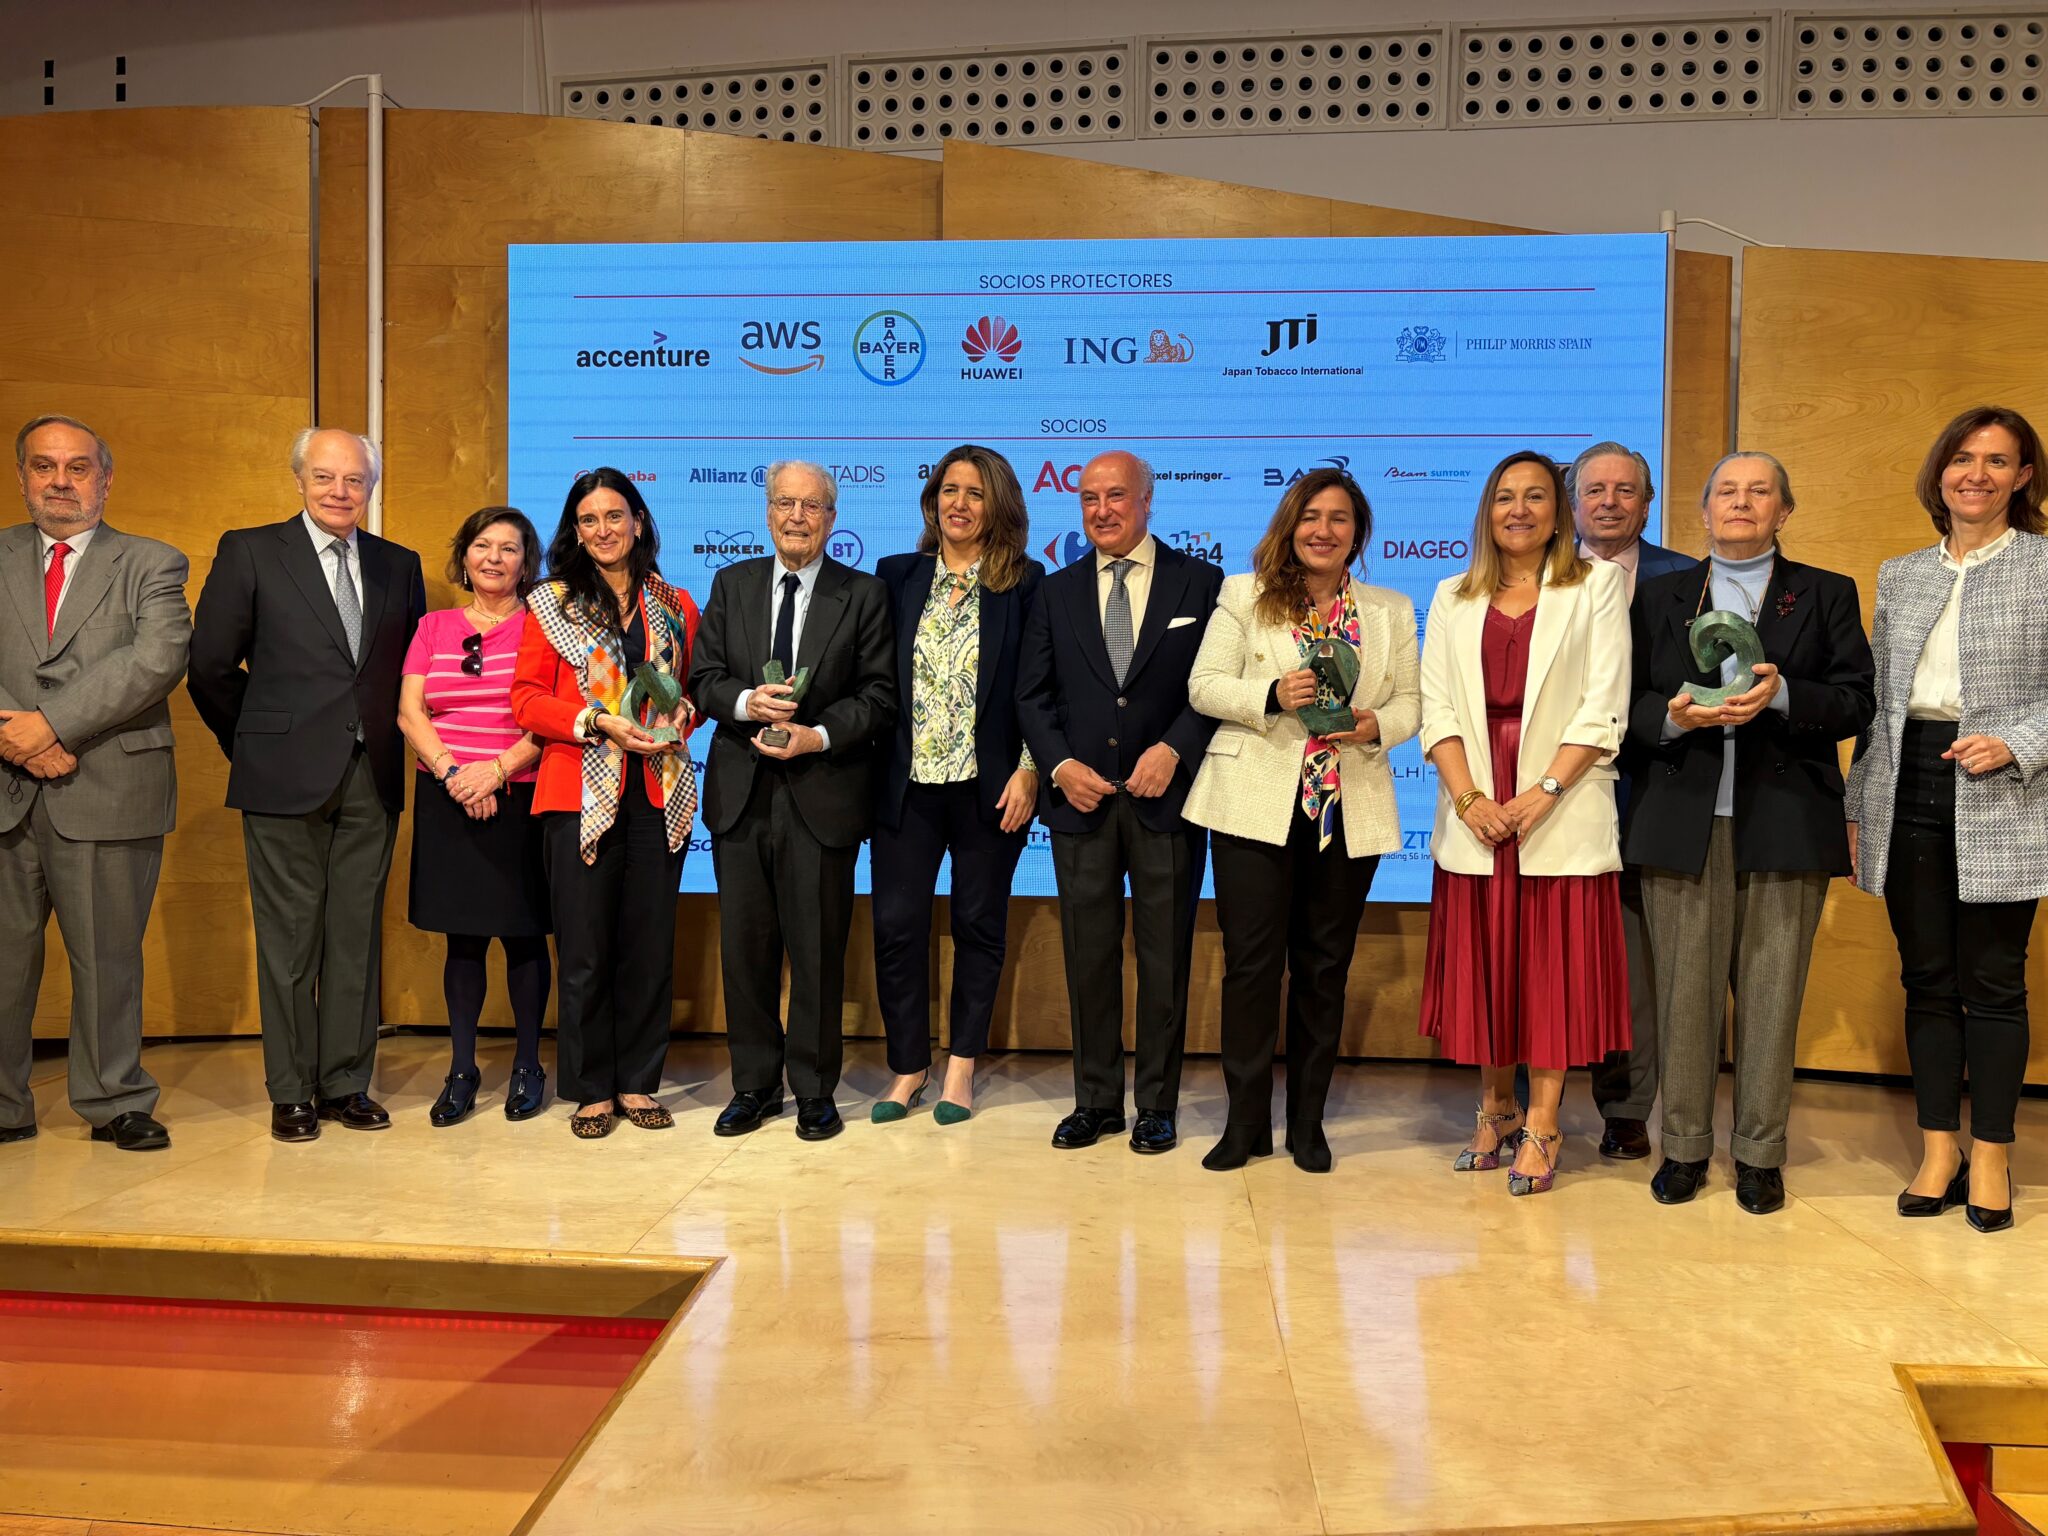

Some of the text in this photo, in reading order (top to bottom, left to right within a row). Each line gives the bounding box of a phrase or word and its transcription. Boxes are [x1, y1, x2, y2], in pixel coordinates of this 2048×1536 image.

[979, 273, 1173, 289] SOCIOS PROTECTORES
[741, 321, 822, 350] aws
[860, 342, 920, 353] BAYER
[883, 316, 896, 379] BAYER
[1064, 337, 1138, 364] ING
[1466, 338, 1592, 350] PHILIP MORRIS SPAIN
[576, 345, 710, 367] accenture
[961, 368, 1023, 379] HUAWEI
[1222, 366, 1364, 378] Japan Tobacco International
[1041, 419, 1107, 433] SOCIOS
[690, 469, 747, 483] Allianz
[1384, 467, 1427, 477] Beam
[694, 545, 764, 554] BRUKER
[833, 543, 854, 557] BT
[1384, 541, 1468, 559] DIAGEO
